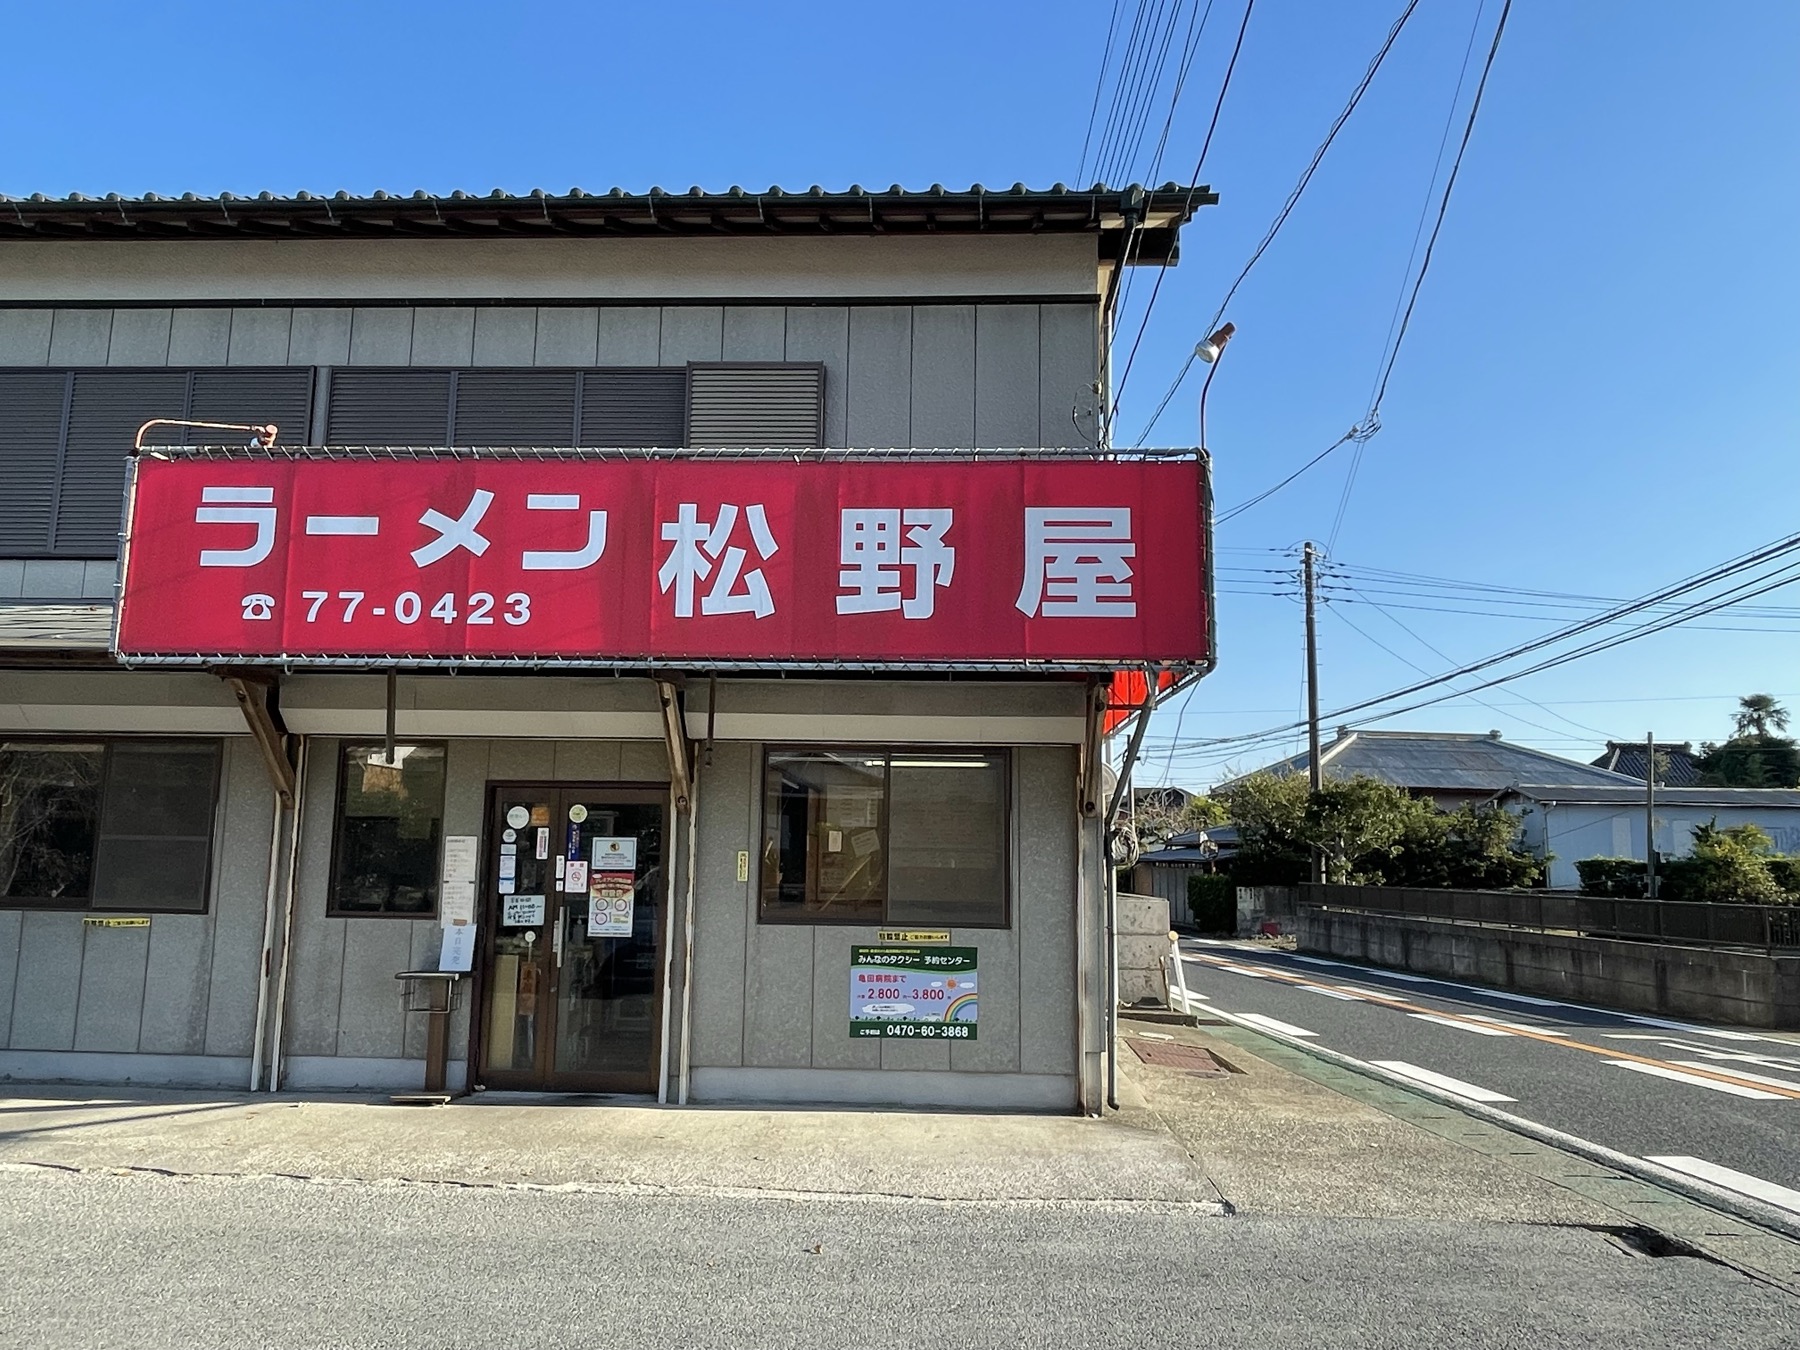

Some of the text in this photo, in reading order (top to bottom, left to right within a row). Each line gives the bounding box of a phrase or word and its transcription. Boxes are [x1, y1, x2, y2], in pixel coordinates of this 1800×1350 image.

[195, 486, 1137, 620] ラーメン 松野屋
[302, 591, 532, 625] 77-0423
[858, 955, 971, 965] みんなのタクシー 予約センター
[858, 974, 907, 983] 亀田病院まで
[886, 1025, 968, 1037] 0470-60-3868
